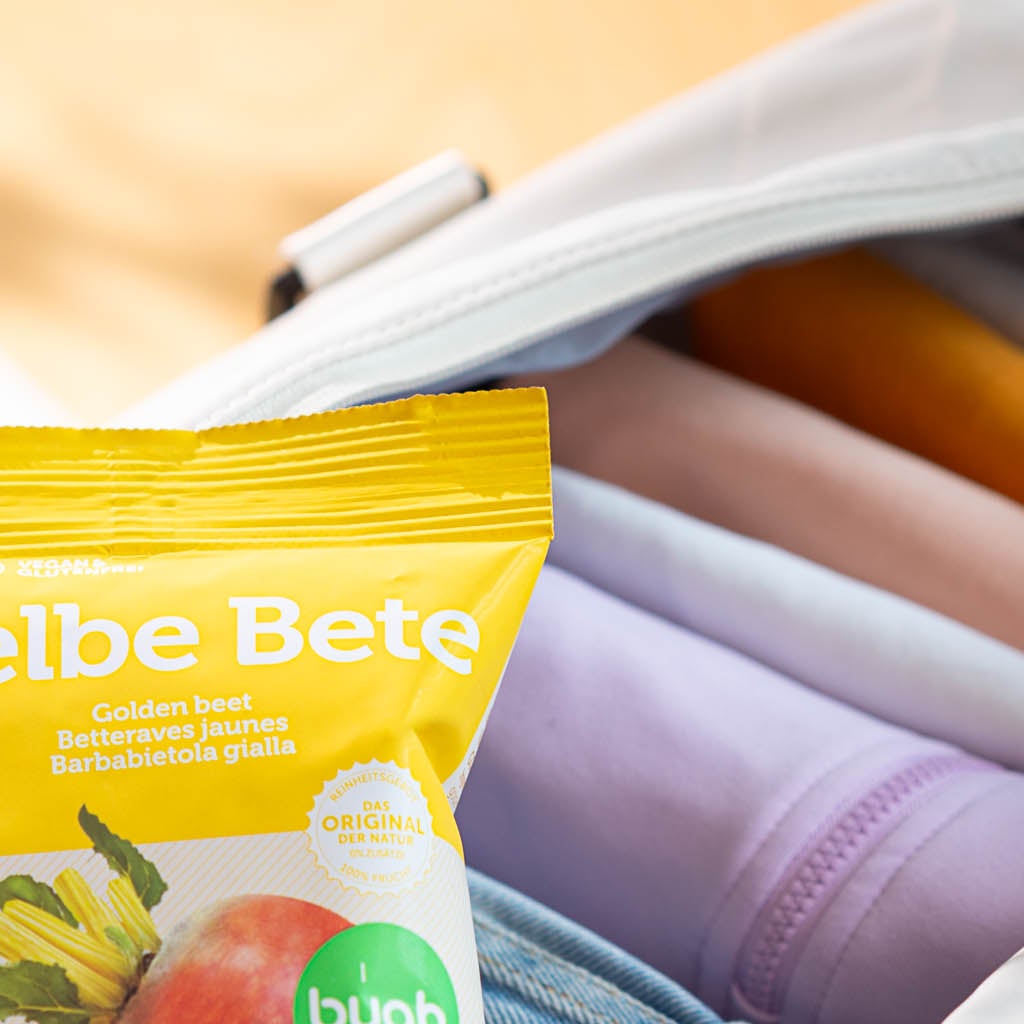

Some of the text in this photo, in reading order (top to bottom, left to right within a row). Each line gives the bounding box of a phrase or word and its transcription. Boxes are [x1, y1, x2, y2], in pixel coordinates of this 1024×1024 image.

[229, 595, 481, 676] Bete
[92, 693, 253, 723] Golden beet
[56, 716, 289, 750] Betteraves jaunes
[50, 736, 297, 775] Barbabietola gialla
[362, 800, 390, 812] DAS
[321, 813, 425, 835] ORIGINAL
[338, 832, 414, 846] DER NATUR
